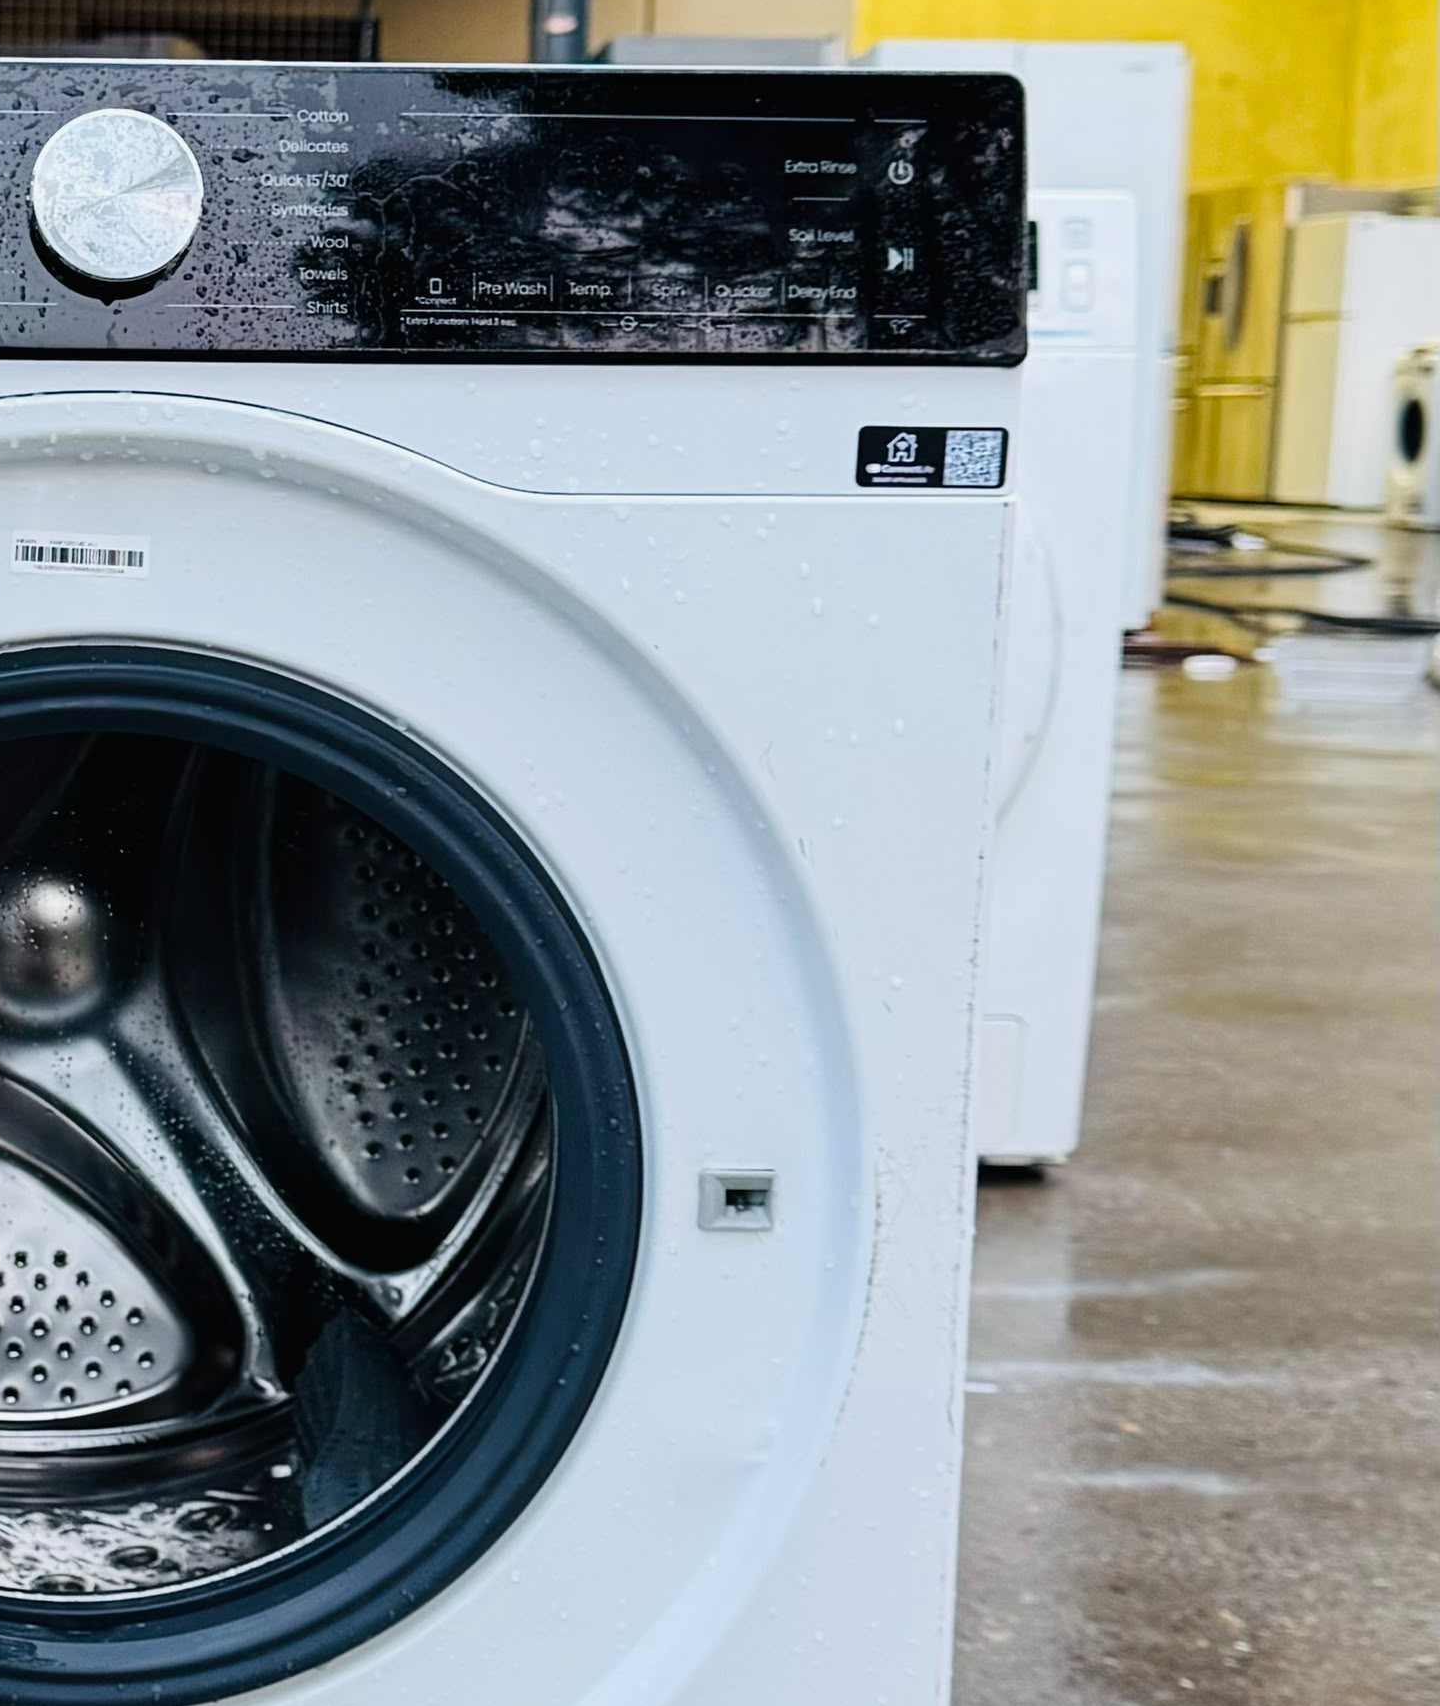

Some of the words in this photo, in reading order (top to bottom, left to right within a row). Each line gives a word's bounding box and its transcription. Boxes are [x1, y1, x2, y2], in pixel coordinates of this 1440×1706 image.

[297, 109, 349, 123] Cotton
[280, 139, 349, 153] Delicates
[784, 159, 818, 174] Extra
[820, 160, 857, 174] Rinse
[261, 173, 304, 187] Quick
[271, 203, 349, 219] Synthetics
[310, 235, 349, 249] Wool
[788, 228, 815, 242] Soil
[817, 229, 855, 243] Level
[298, 266, 348, 281] Towels
[478, 281, 502, 295] Pre
[505, 282, 547, 295] Wash
[569, 281, 613, 299] Temp.
[307, 300, 348, 314] Shirts
